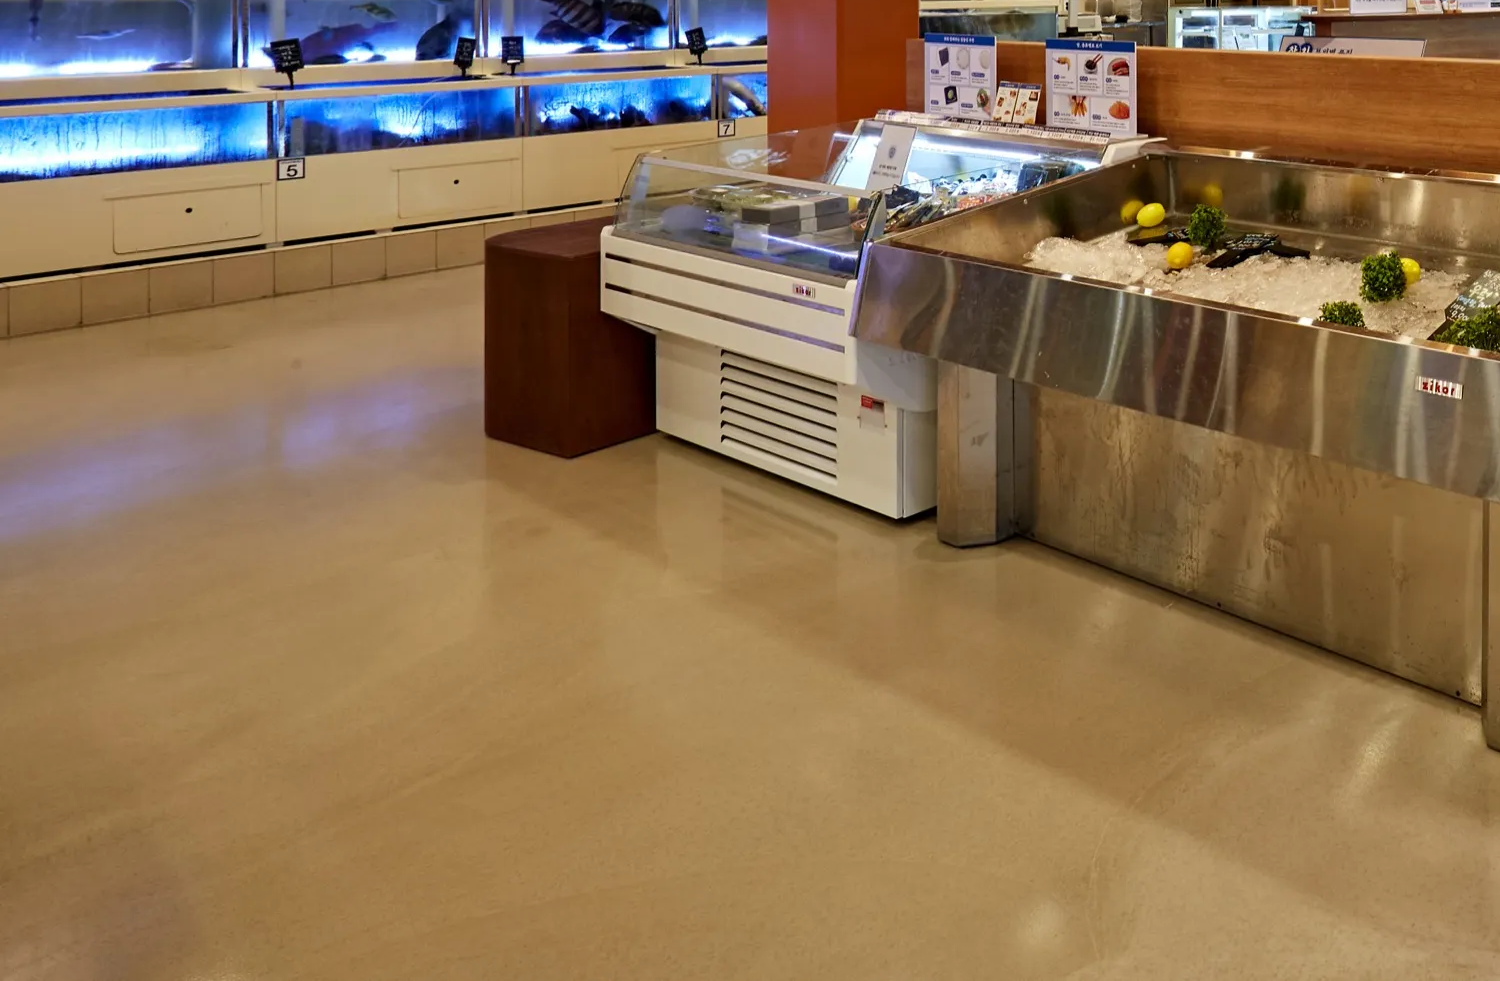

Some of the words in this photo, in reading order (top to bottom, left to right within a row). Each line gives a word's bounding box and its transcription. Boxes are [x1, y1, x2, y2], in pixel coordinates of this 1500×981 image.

[723, 124, 730, 135] 7
[286, 164, 298, 177] 5
[1422, 380, 1455, 396] zikor
